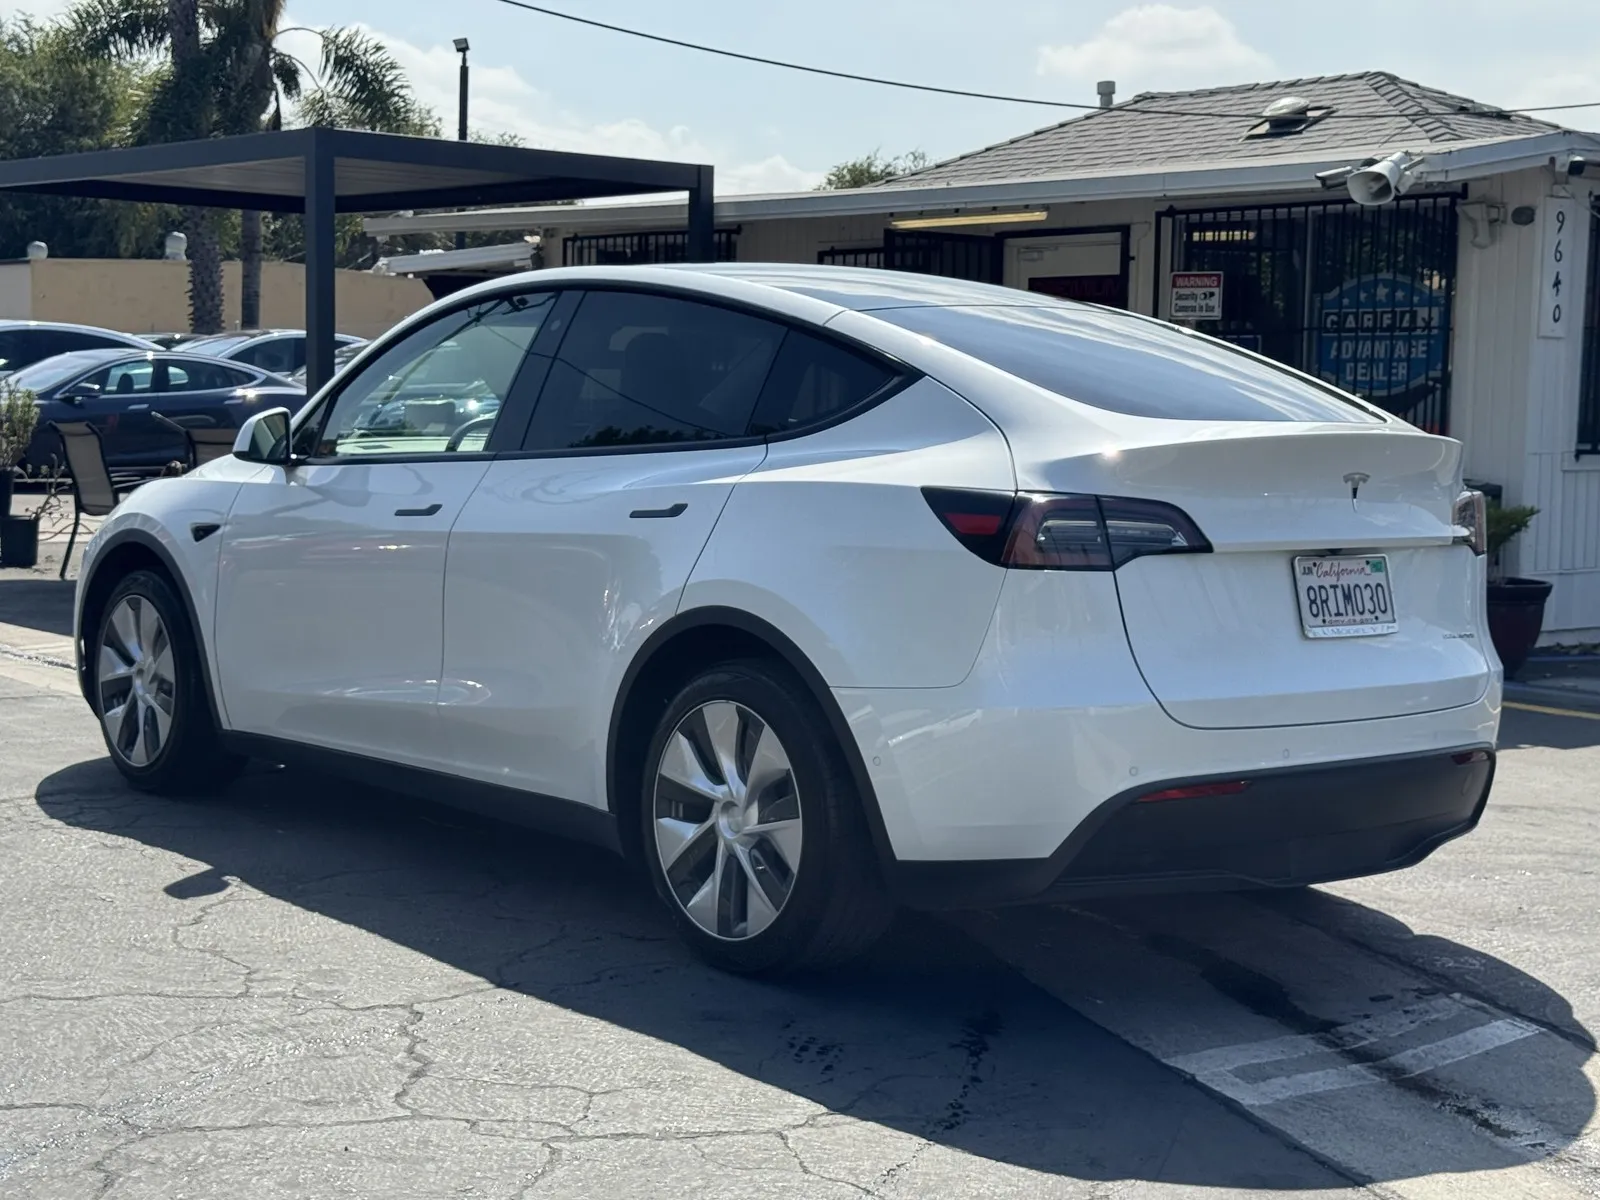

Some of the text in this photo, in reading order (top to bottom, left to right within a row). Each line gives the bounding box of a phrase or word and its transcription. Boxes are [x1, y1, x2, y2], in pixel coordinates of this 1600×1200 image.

[1552, 210, 1565, 323] 9640
[1175, 276, 1218, 287] WARNING
[1174, 291, 1198, 303] Security
[1174, 303, 1197, 313] Cameras
[1205, 303, 1216, 313] Use
[1325, 312, 1438, 333] CARFAX
[1330, 340, 1428, 359] ADVANTAGE
[1345, 362, 1408, 380] DEALER
[1316, 561, 1371, 583] California
[1307, 583, 1388, 618] 8RIM030
